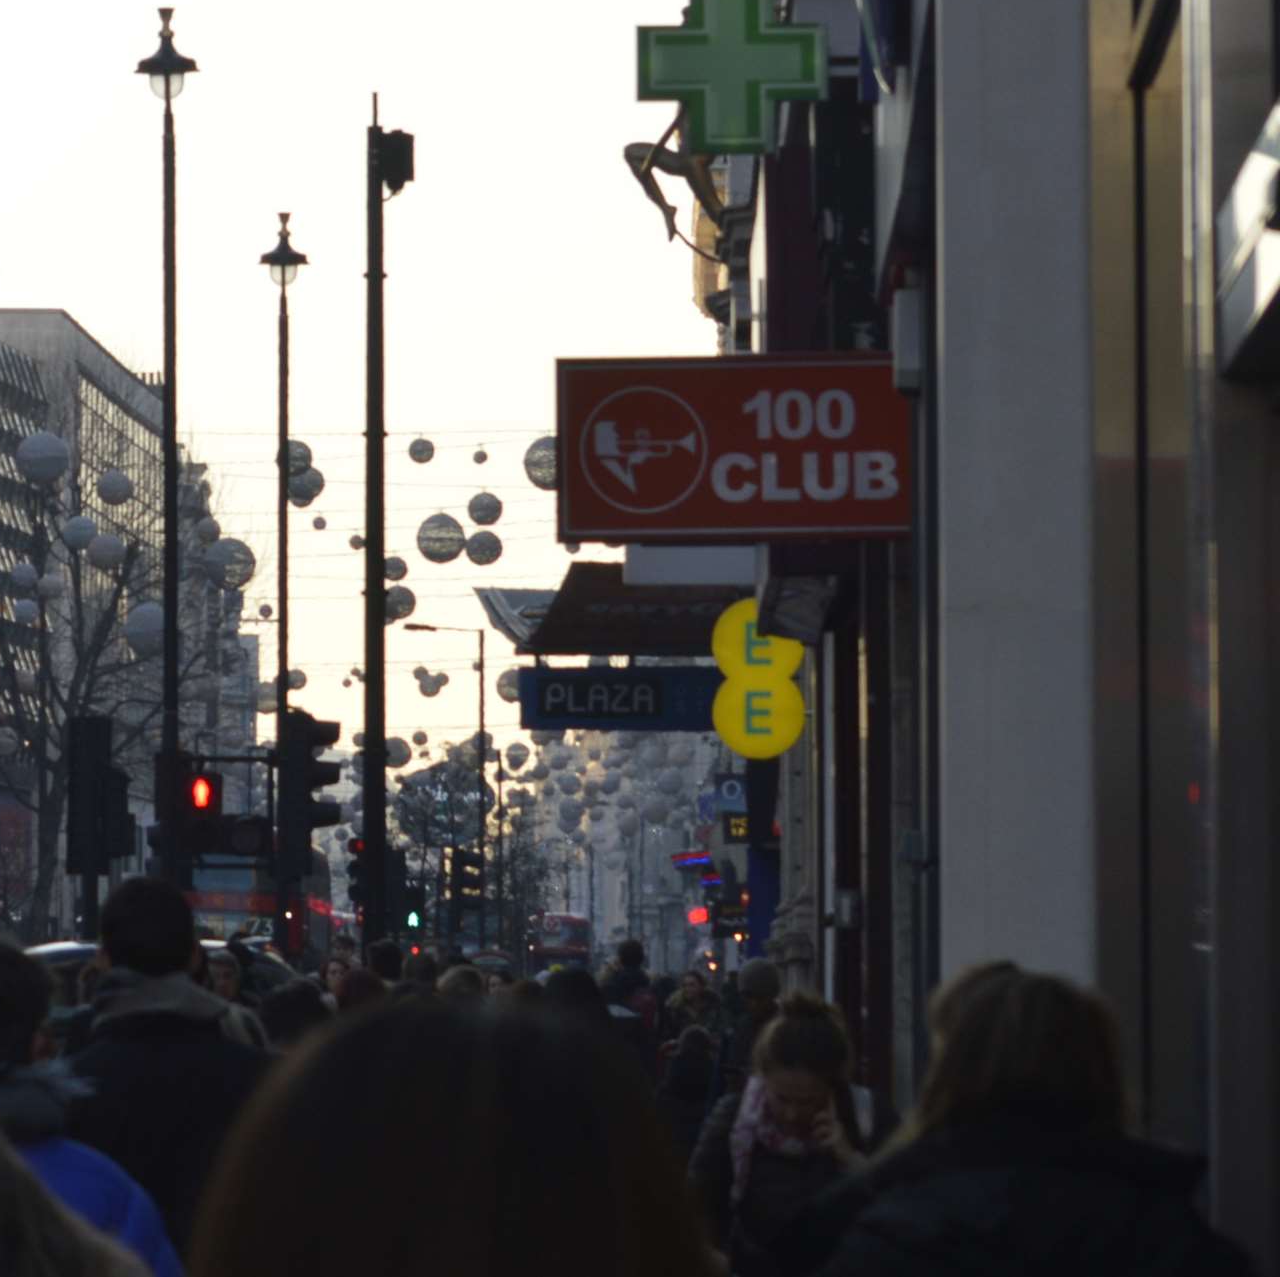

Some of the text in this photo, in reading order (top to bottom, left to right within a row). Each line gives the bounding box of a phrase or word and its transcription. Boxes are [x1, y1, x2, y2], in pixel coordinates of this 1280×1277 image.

[743, 388, 856, 441] 100
[710, 451, 900, 504] CLUB
[545, 683, 654, 713] PLAZA
